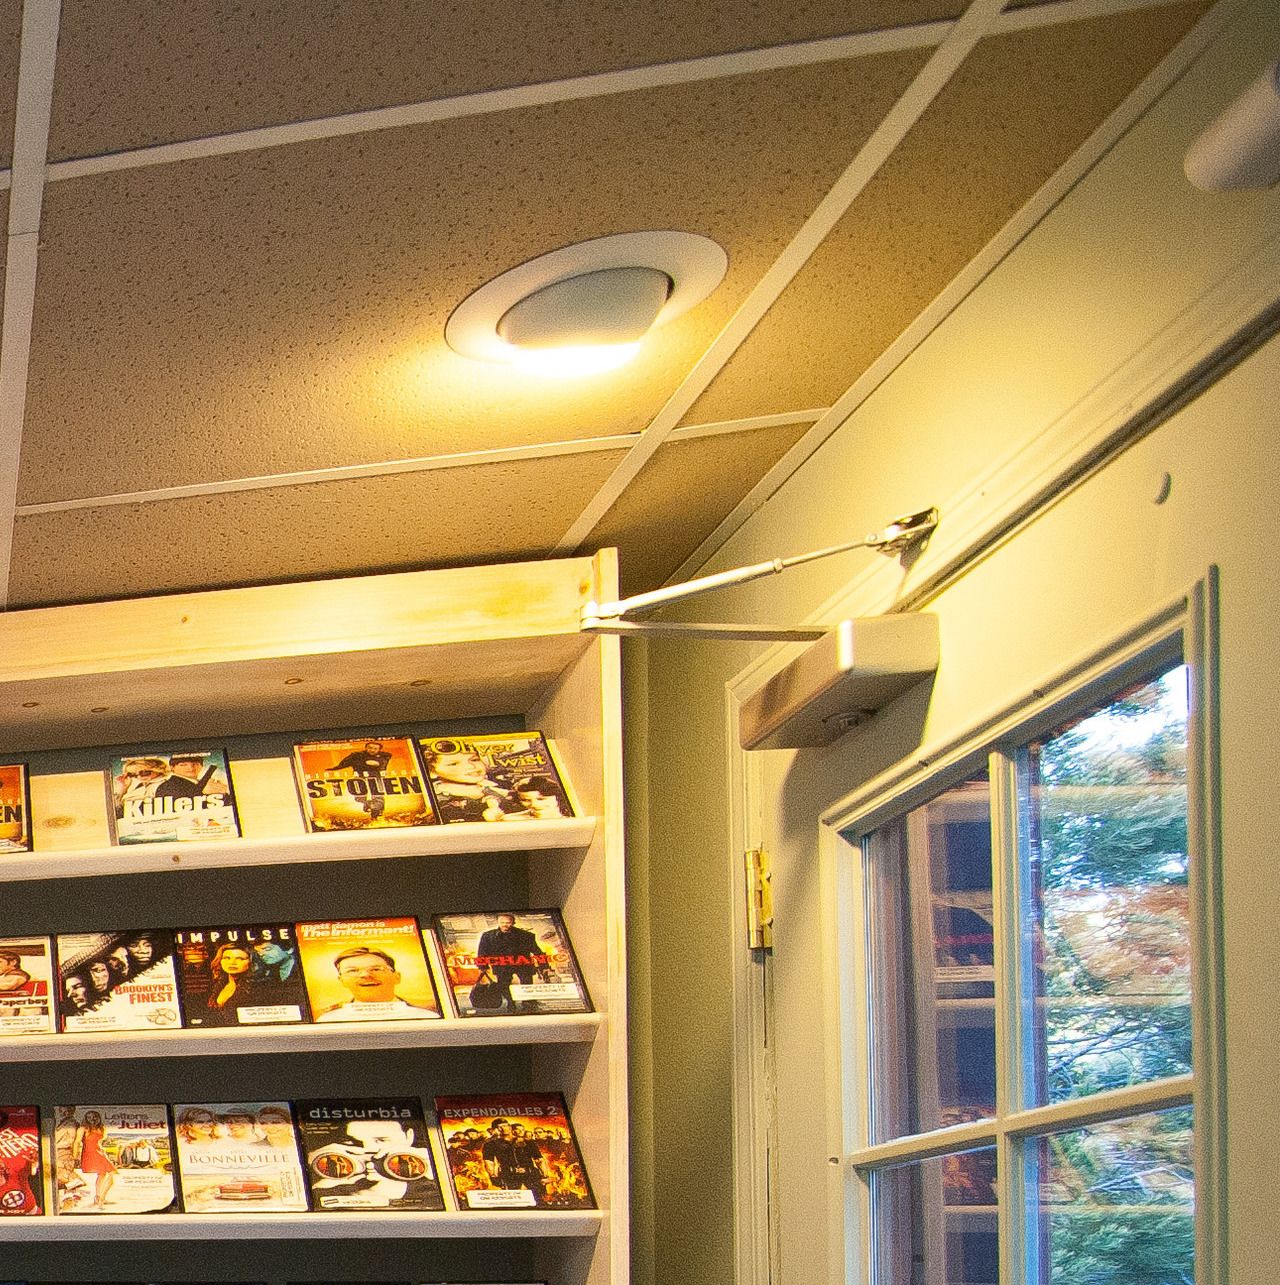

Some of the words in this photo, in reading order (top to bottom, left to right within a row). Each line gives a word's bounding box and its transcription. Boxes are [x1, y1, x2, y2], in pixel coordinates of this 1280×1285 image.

[489, 751, 546, 767] Twist
[306, 775, 422, 799] STOLEN
[123, 793, 225, 818] Killers
[177, 928, 290, 944] IMPULSE
[129, 992, 173, 1004] FINEST
[309, 1107, 412, 1120] disturbia
[443, 1106, 544, 1119] EXPENDABLES
[547, 1106, 558, 1116] 2
[118, 1119, 167, 1130] Juliet
[1, 1133, 39, 1158] HERO
[189, 1152, 289, 1165] BONNEVILLE
